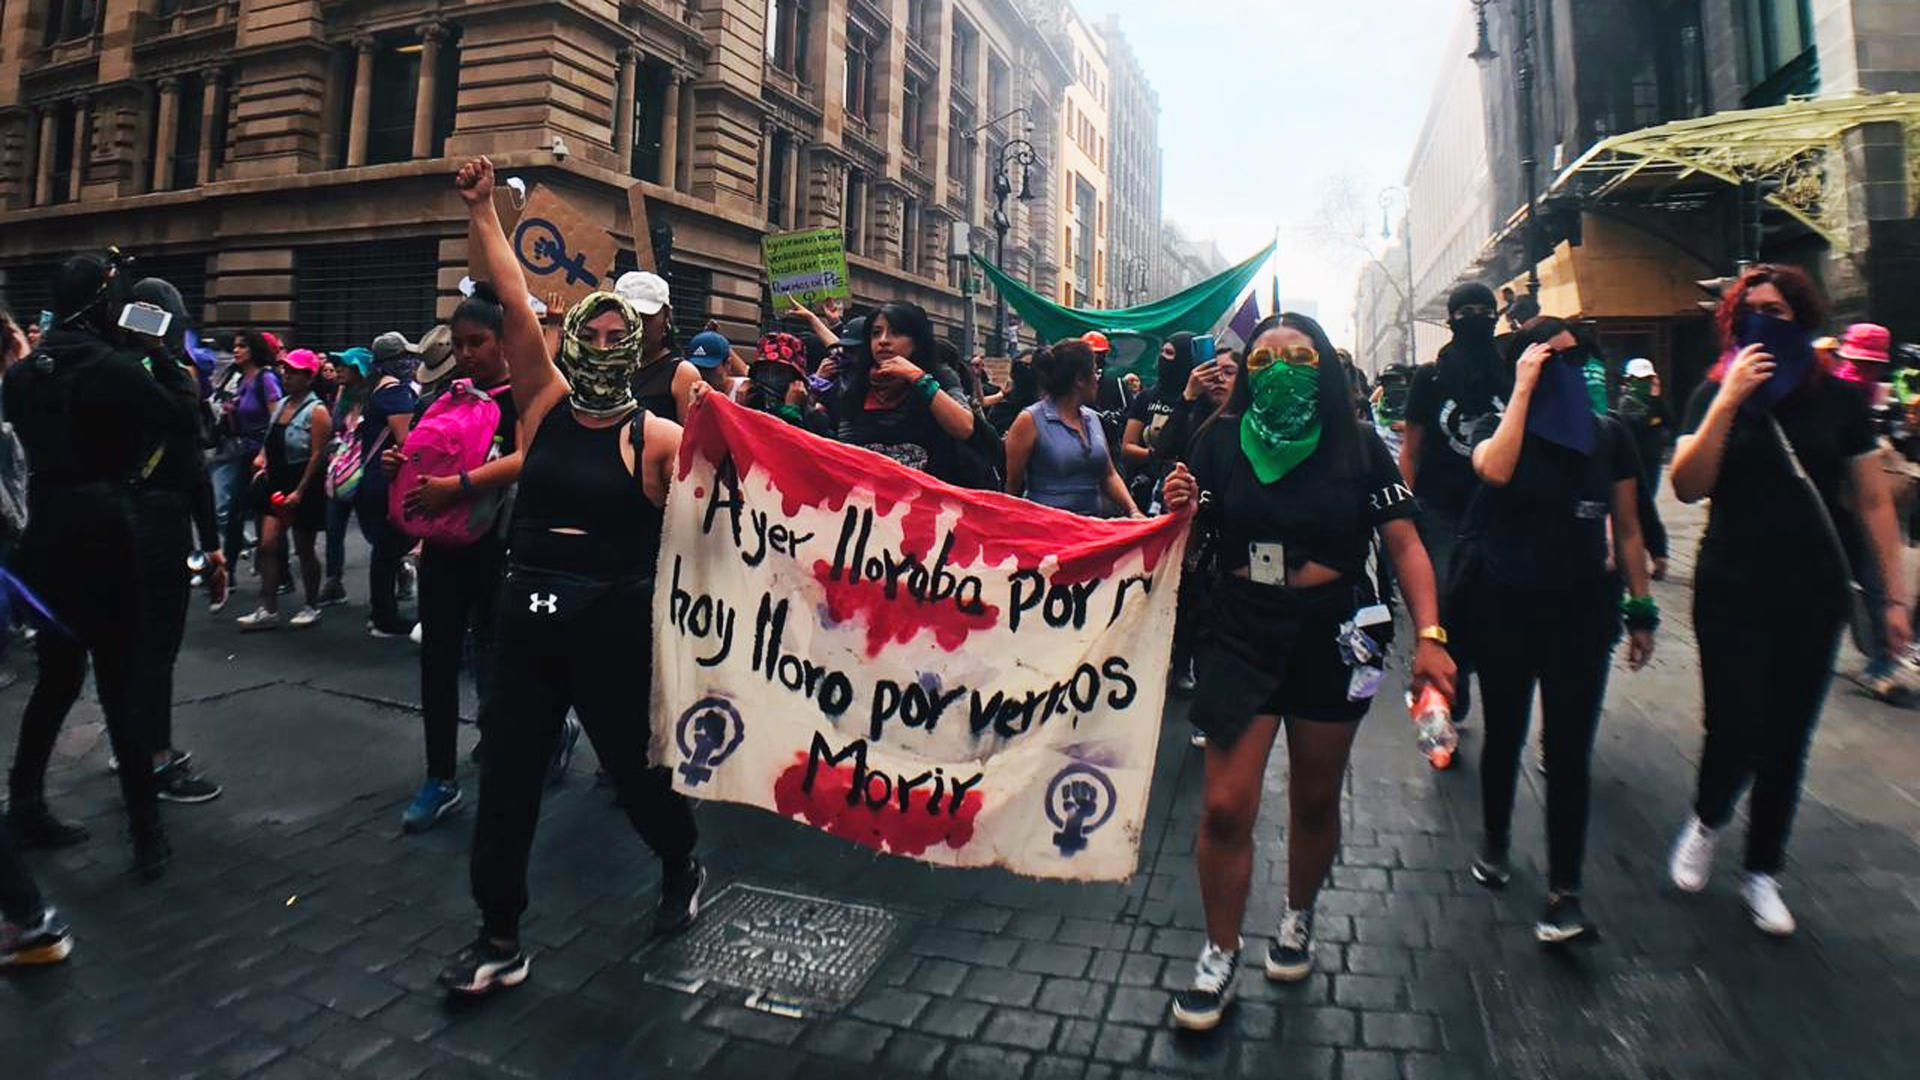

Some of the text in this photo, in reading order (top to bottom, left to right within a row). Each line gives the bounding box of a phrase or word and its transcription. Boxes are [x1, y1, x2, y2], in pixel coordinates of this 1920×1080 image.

[703, 452, 815, 568] Ayer
[830, 504, 985, 616] lloraba
[670, 554, 736, 667] hoy
[752, 591, 853, 718] lloro
[870, 679, 967, 742] por
[802, 730, 984, 816] Morir
